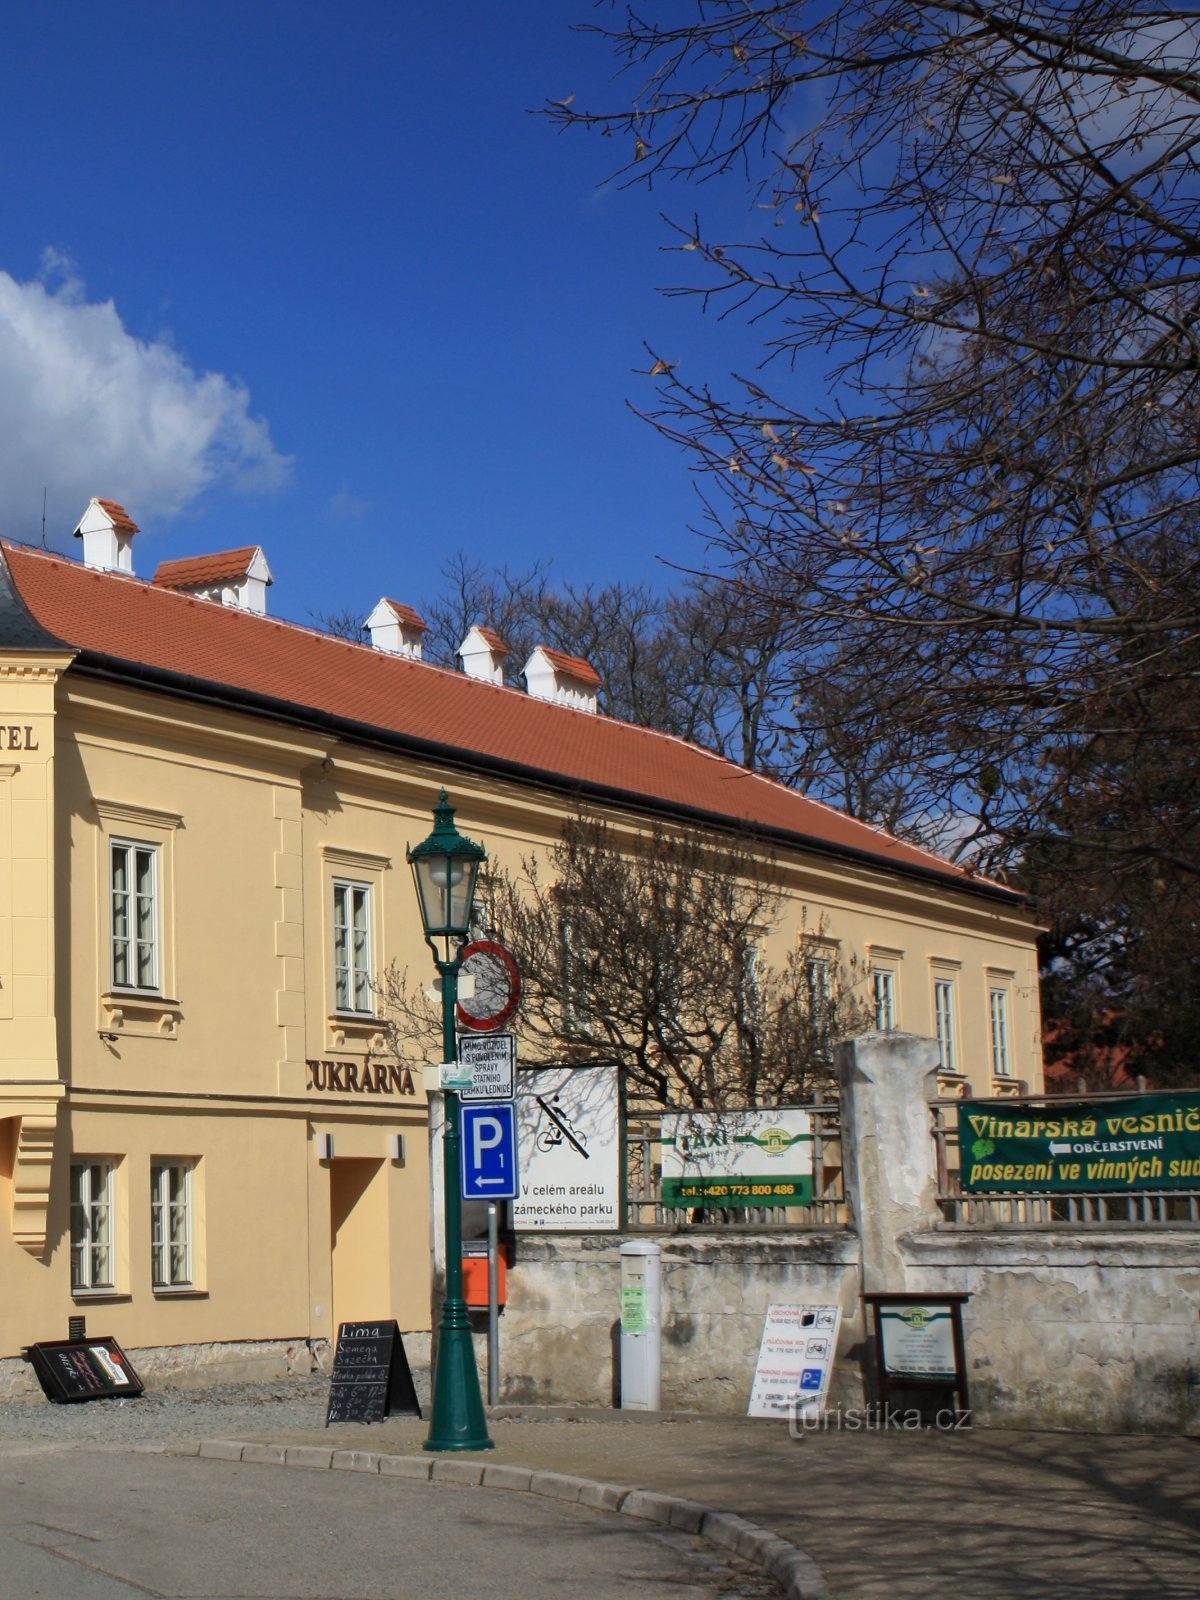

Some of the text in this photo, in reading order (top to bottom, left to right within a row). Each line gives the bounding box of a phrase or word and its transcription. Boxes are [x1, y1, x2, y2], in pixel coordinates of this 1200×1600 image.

[968, 1114, 1097, 1138] Vinařská
[473, 1116, 503, 1169] P
[1073, 1136, 1164, 1154] OBČERSTVENÍ
[499, 1153, 504, 1168] 1
[970, 1158, 1054, 1185] posezení
[1059, 1163, 1081, 1180] ve
[1087, 1155, 1163, 1184] vinných
[522, 1183, 604, 1195] V celém areálu
[730, 1185, 750, 1195] 773
[752, 1185, 771, 1195] 800
[773, 1184, 794, 1195] 486
[514, 1203, 613, 1217] zámeckého parku
[341, 1324, 380, 1338] Lima
